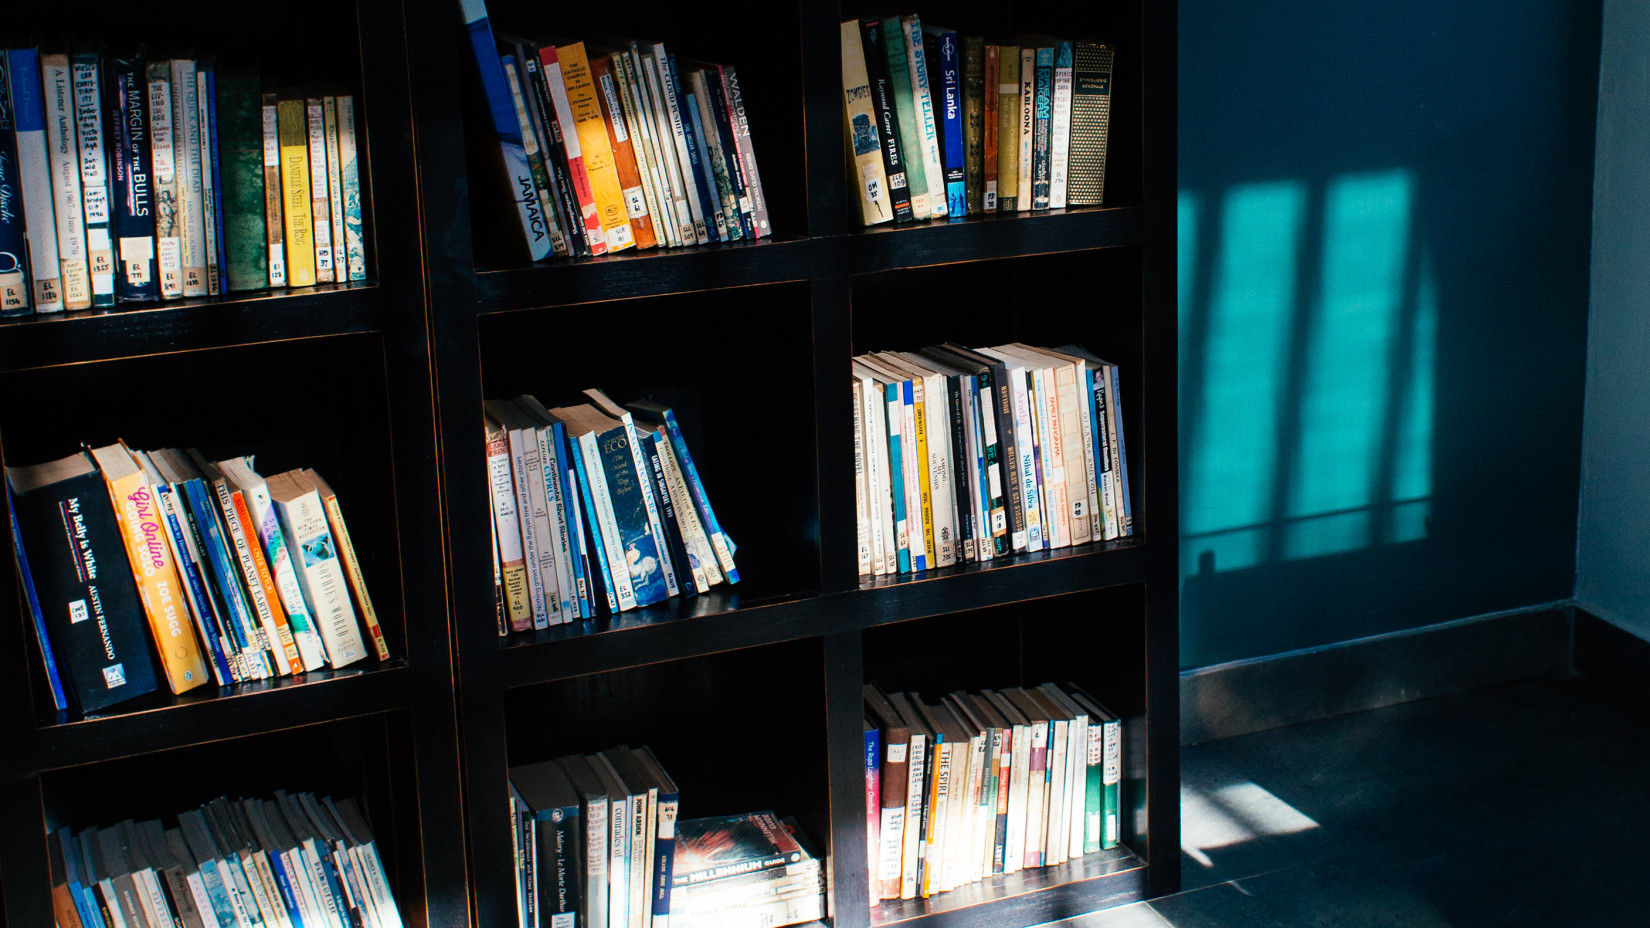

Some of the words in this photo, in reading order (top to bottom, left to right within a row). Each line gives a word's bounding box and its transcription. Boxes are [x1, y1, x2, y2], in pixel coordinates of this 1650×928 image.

[910, 20, 922, 48] THE
[55, 69, 64, 77] A
[564, 66, 586, 76] CATHOLIC
[566, 72, 586, 81] CHURCH
[660, 57, 668, 72] The
[945, 70, 956, 84] Sri
[187, 72, 195, 87] THE
[606, 74, 618, 102] MOROCCO
[664, 74, 677, 103] CLOUD
[56, 79, 66, 112] Listener
[187, 91, 197, 121] QUICK
[729, 72, 751, 137] WALDEN
[845, 85, 870, 105] ZOMBIES
[878, 79, 890, 110] Raymond
[914, 50, 937, 141] STORY-TELLER
[946, 86, 958, 121] Lanka
[1043, 68, 1051, 119] DREAM
[128, 91, 143, 141] MARGIN
[670, 103, 684, 137] PUSHER
[1023, 81, 1032, 135] KABLOONA
[58, 114, 70, 154] Anthology
[189, 124, 199, 147] AND
[883, 111, 894, 136] Carver
[132, 143, 139, 153] OF
[190, 149, 200, 167] THE
[887, 138, 899, 166] FIRES
[62, 160, 73, 186] August
[115, 142, 124, 181] ROBINSON
[132, 155, 140, 171] THE
[191, 168, 200, 193] DEAD
[893, 179, 906, 187] 109
[133, 174, 149, 217] BULLS
[753, 187, 765, 213] THOREAU
[293, 213, 306, 227] THE
[518, 176, 545, 242] JAMAICA
[70, 237, 80, 255] 1970
[294, 228, 307, 246] RING
[6, 288, 16, 296] EL
[43, 283, 53, 291] EL
[1016, 391, 1028, 425] Arathi
[1050, 396, 1058, 421] FAMILY
[1052, 421, 1061, 458] PANORAMA
[1083, 424, 1093, 454] LANKA
[1100, 409, 1108, 445] Supernatural
[539, 440, 549, 464] EXPLORE
[604, 438, 628, 454] ECO
[663, 439, 677, 472] TROLLOPE
[1006, 446, 1017, 469] NATION
[516, 456, 526, 477] stories
[588, 443, 597, 460] TOBIAS
[593, 461, 603, 485] SMOLLETT
[612, 455, 624, 463] The
[626, 422, 643, 462] PEACOCK
[639, 463, 656, 514] FEATHERS
[1022, 454, 1033, 477] Nihal
[1087, 458, 1095, 475] AND
[1113, 456, 1121, 484] FONSEKA
[543, 465, 555, 502] CYPRUS
[549, 457, 562, 503] Continental
[651, 454, 661, 474] EATING
[659, 480, 671, 506] SINGAPORE
[665, 463, 674, 481] DOYLE
[932, 452, 941, 492] SOUVENIRS
[519, 478, 529, 493] other
[68, 497, 79, 513] My
[1026, 488, 1036, 509] Silva
[557, 503, 566, 524] Short
[73, 513, 87, 540] Belly
[128, 486, 150, 520] Girl
[140, 522, 164, 570] Online
[525, 517, 536, 539] Banyan
[560, 525, 569, 553] Stories
[79, 536, 89, 550] is
[125, 501, 145, 542] GOING
[138, 542, 155, 578] SOLO
[169, 514, 179, 531] Death
[178, 540, 191, 567] Drowning
[233, 493, 247, 520] ROALD
[242, 519, 255, 544] DAHL
[252, 547, 264, 568] OVER
[264, 576, 275, 595] YOU
[263, 520, 283, 566] HAWKING
[269, 518, 287, 561] STEPHEN
[83, 549, 97, 580] White
[217, 484, 230, 506] THIS
[225, 506, 240, 536] PIECE
[235, 538, 246, 557] OF
[241, 554, 260, 593] PLANET
[254, 591, 270, 621] EARTH
[529, 550, 538, 568] under
[530, 569, 540, 588] grows
[619, 585, 627, 593] EL
[156, 580, 171, 600] ZOE
[164, 599, 182, 638] SUGG
[318, 562, 338, 605] SOPHIE'S
[331, 605, 350, 638] WORLD
[532, 589, 543, 611] Nothing
[88, 585, 103, 617] AUSTIN
[96, 614, 116, 661] FERNANDO
[299, 612, 314, 644] HISTORY
[866, 741, 874, 752] The
[866, 752, 875, 767] Rupa
[939, 750, 953, 773] THE
[866, 766, 875, 790] Laughter
[937, 773, 950, 797] SPIRE
[588, 804, 606, 812] CRIME
[635, 798, 643, 815] JOHN
[866, 790, 875, 815] Omnibus
[614, 807, 625, 846] comrades
[635, 815, 643, 836] ARDEN
[555, 829, 565, 854] Malory
[366, 852, 376, 871] HOMER
[994, 844, 1004, 867] JARRY
[283, 854, 295, 880] UNCLE
[291, 879, 305, 911] ARTHUR
[557, 867, 567, 887] Morte
[673, 876, 689, 886] THE
[689, 860, 763, 882] MILLENNIUM
[763, 856, 786, 867] GUIDE
[558, 886, 568, 914] Darthur
